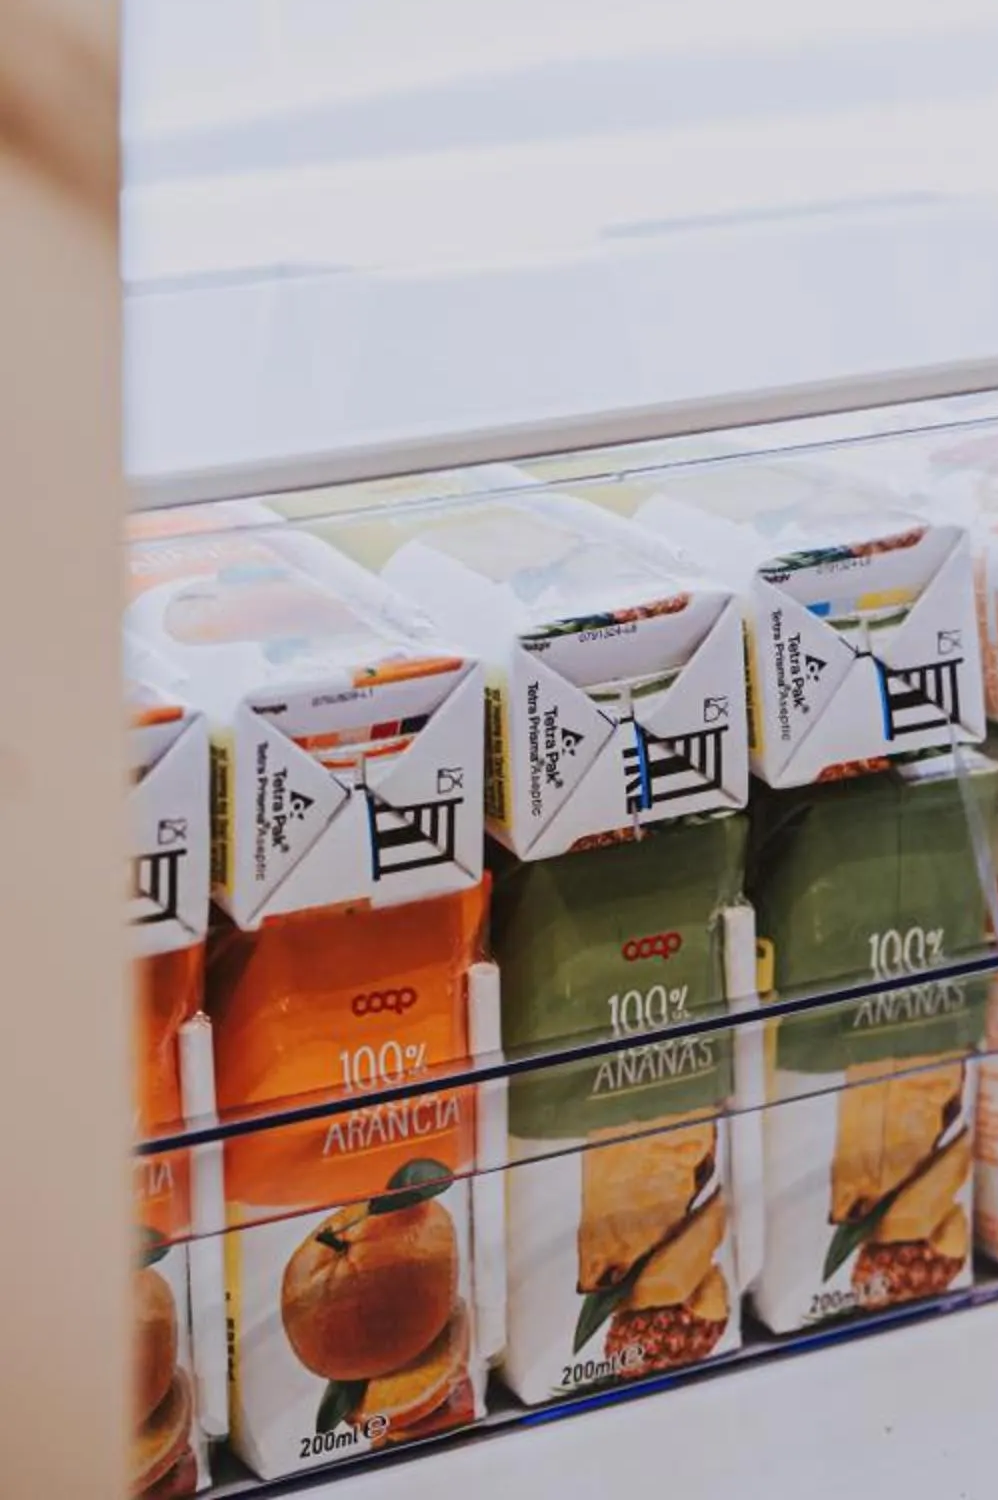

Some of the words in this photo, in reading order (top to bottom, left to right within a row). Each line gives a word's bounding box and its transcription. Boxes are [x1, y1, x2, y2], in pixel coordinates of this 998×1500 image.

[787, 632, 801, 675] Tetra
[543, 705, 558, 751] Tetra
[272, 768, 288, 813] Tetra
[622, 931, 683, 961] coop
[868, 926, 945, 981] 100%
[351, 986, 419, 1017] coop
[607, 984, 689, 1037] 100%
[339, 1040, 427, 1094] 100%
[591, 1038, 715, 1093] ANANAS
[321, 1094, 461, 1157] ARANCIA
[561, 1354, 615, 1386] 200ml
[300, 1424, 359, 1458] 200ml
